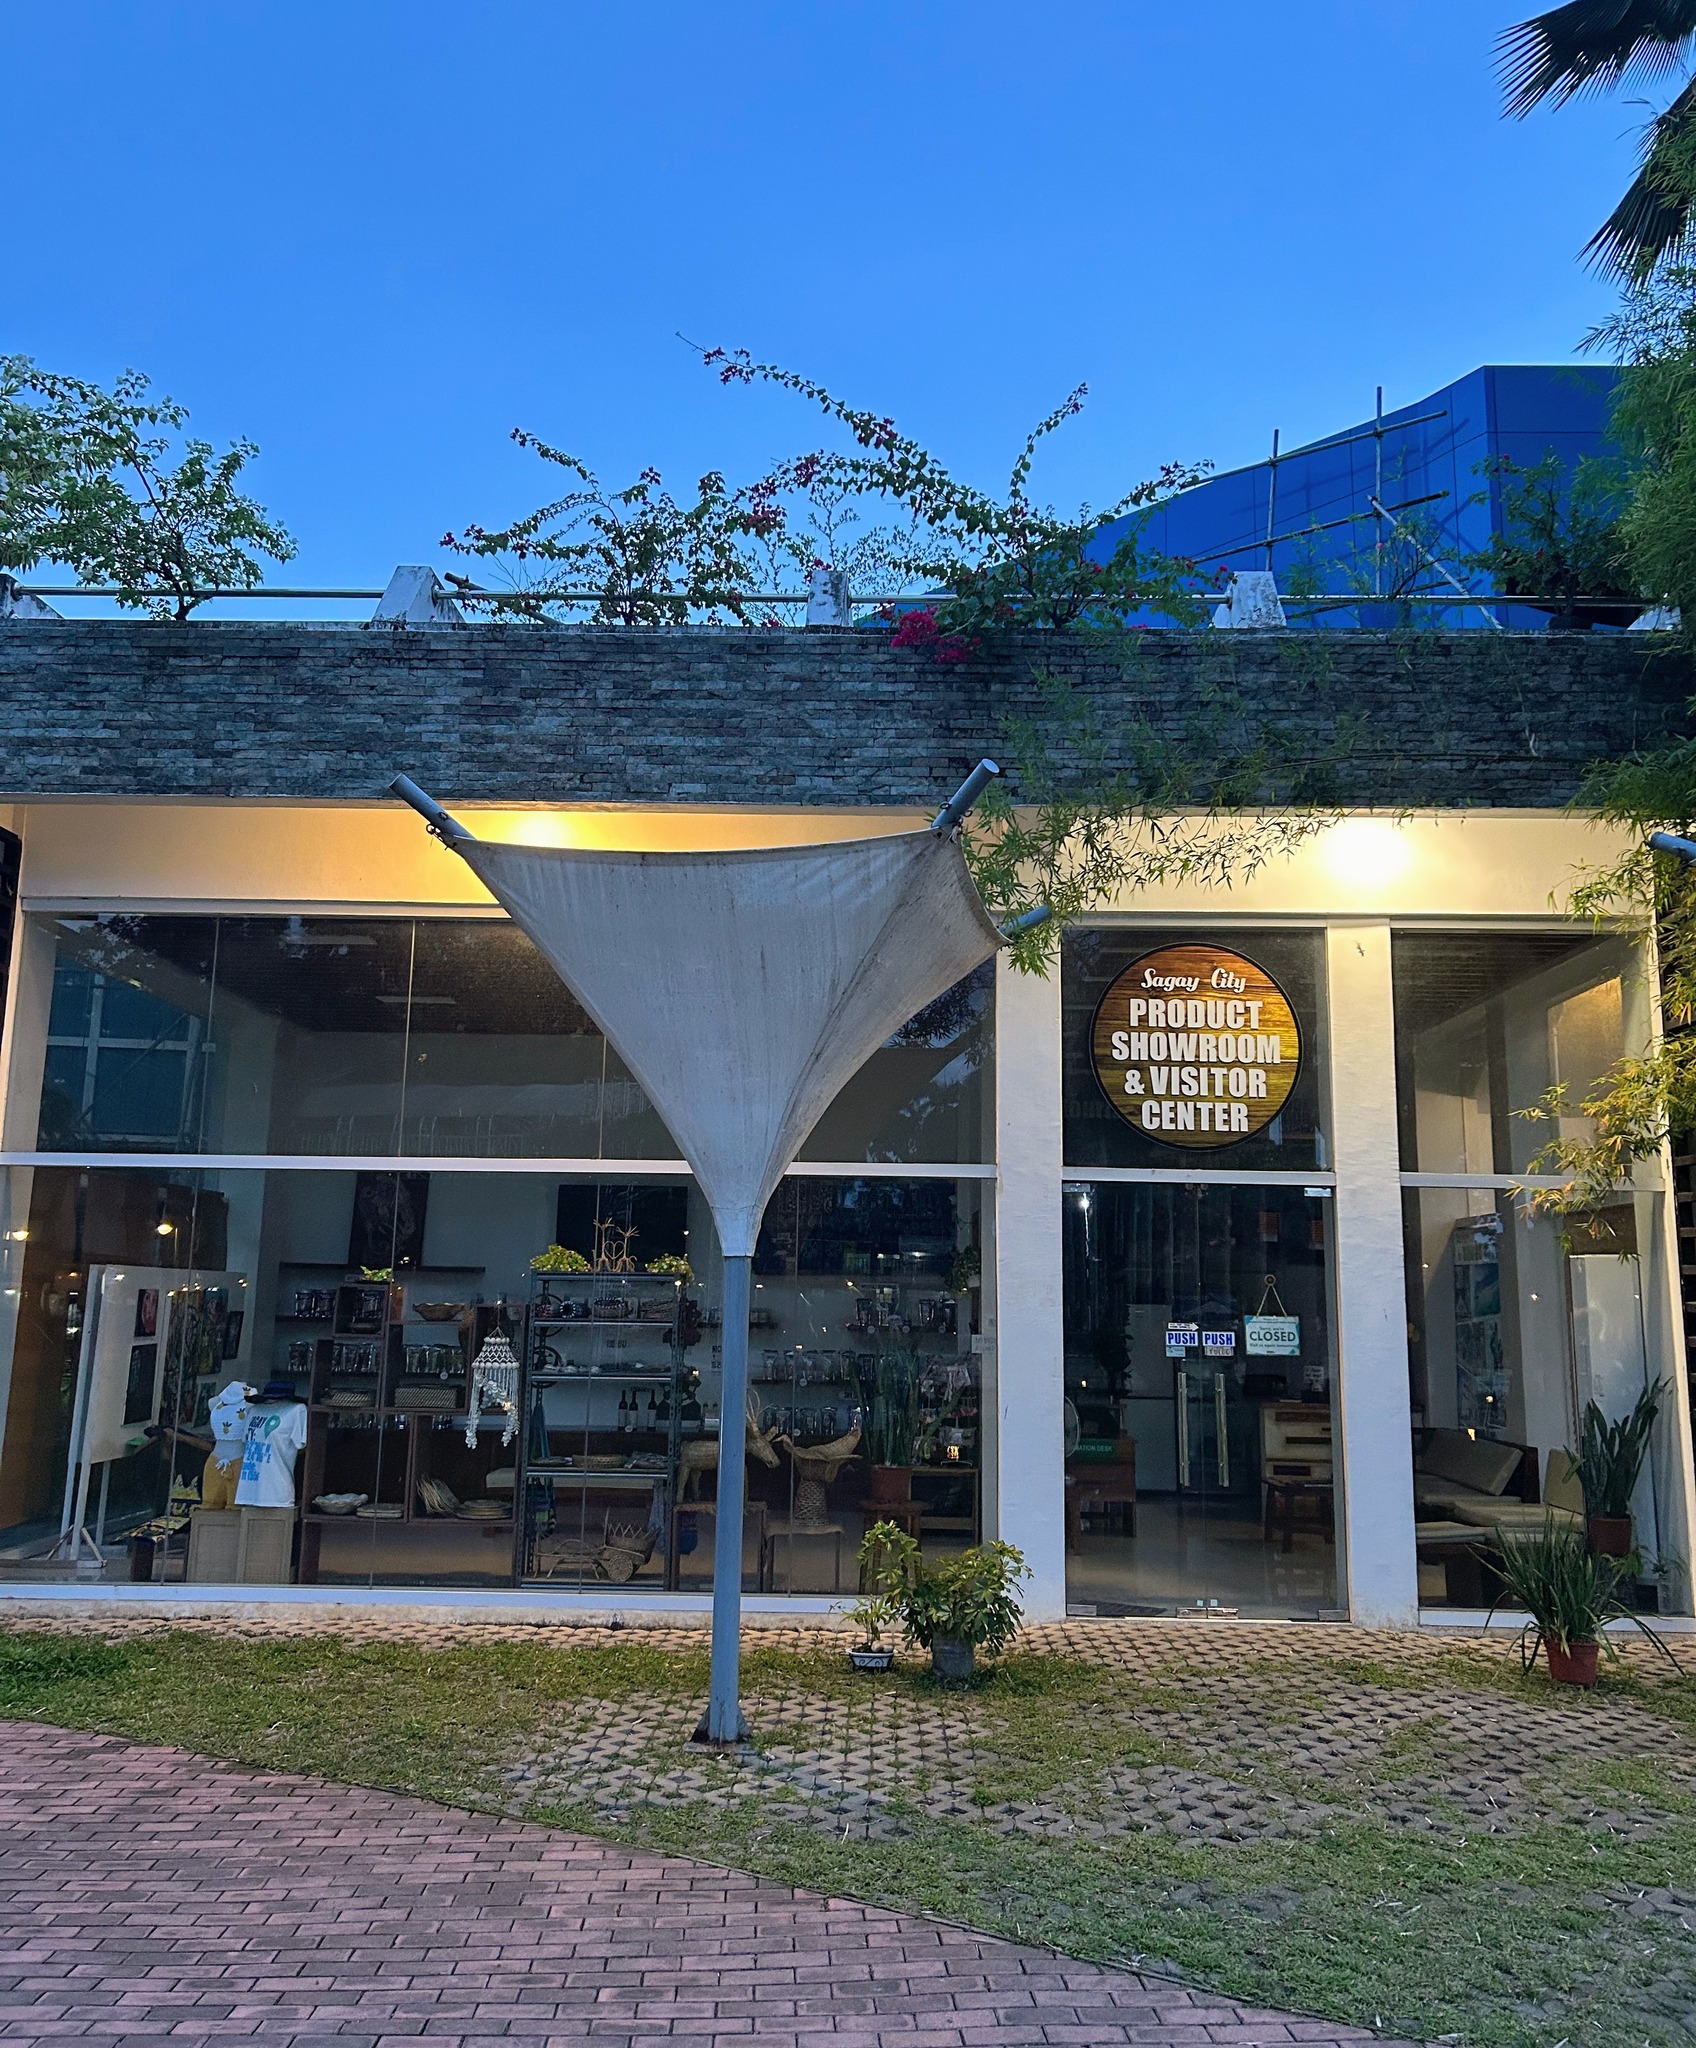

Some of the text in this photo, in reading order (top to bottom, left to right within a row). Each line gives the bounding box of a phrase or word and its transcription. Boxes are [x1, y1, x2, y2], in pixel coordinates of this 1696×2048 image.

[1141, 968, 1247, 993] Sagay City
[1129, 998, 1263, 1030] PRODUCT
[1111, 1031, 1281, 1064] SHOWROOM
[1124, 1066, 1267, 1098] & VISITOR
[1141, 1100, 1249, 1132] CENTER
[1167, 1332, 1196, 1345] PUSH
[1204, 1333, 1233, 1346] PUSH
[1249, 1331, 1296, 1342] CLOSED
